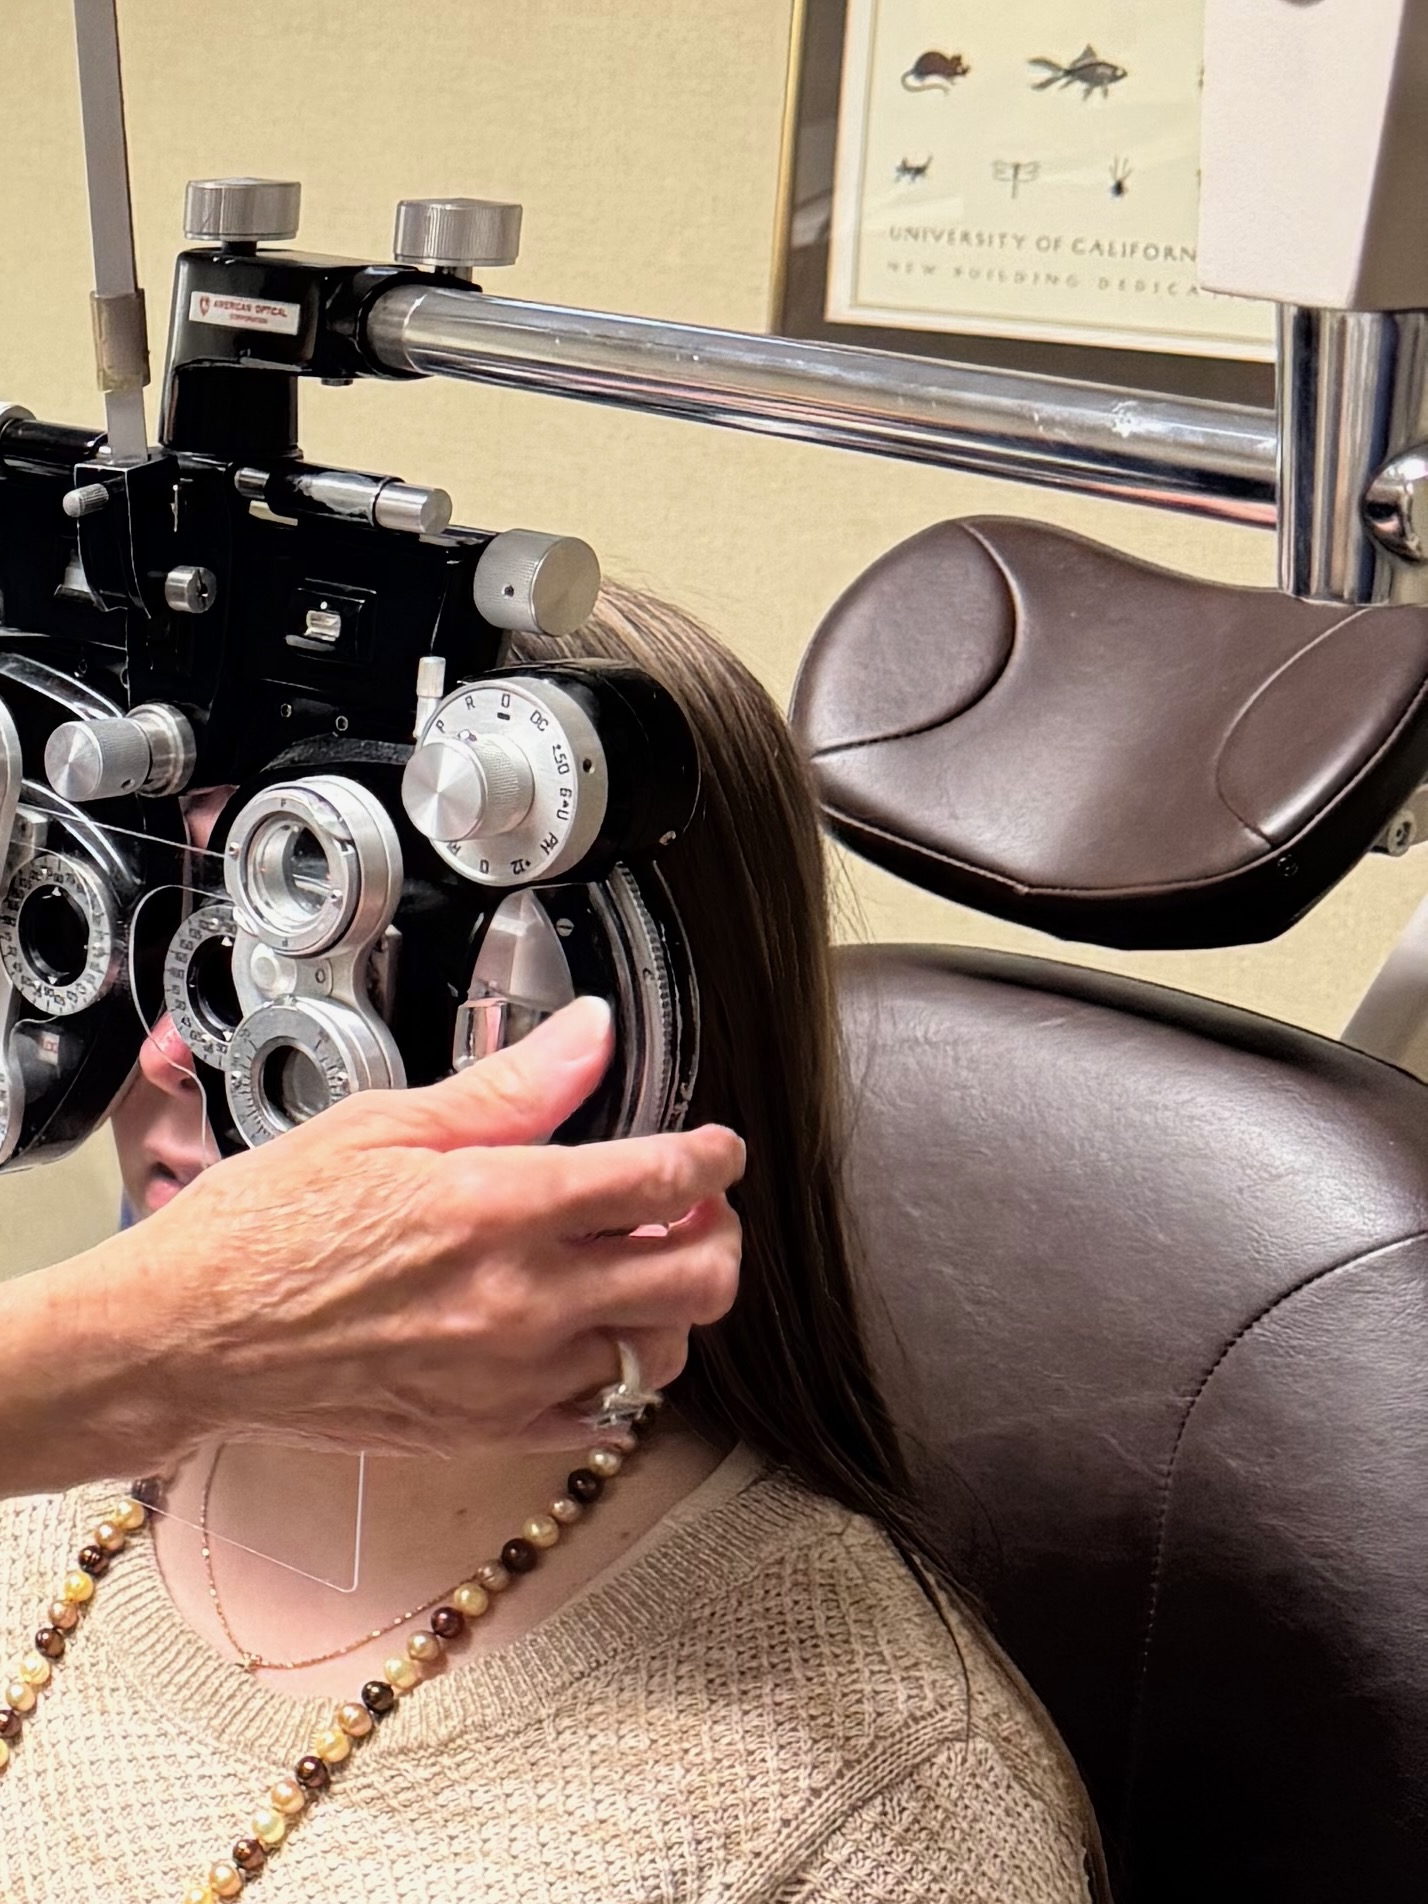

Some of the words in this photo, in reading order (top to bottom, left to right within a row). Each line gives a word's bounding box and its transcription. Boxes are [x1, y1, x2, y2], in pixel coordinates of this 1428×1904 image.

[888, 225, 1028, 250] UNIVERSITY
[1035, 235, 1062, 253] OF
[1071, 237, 1197, 263] CALIFORN
[1097, 276, 1200, 296] DEDICA
[213, 300, 252, 313] AMERICAN
[255, 304, 287, 318] OPTICAL
[465, 695, 476, 711] R
[540, 831, 559, 856] PH
